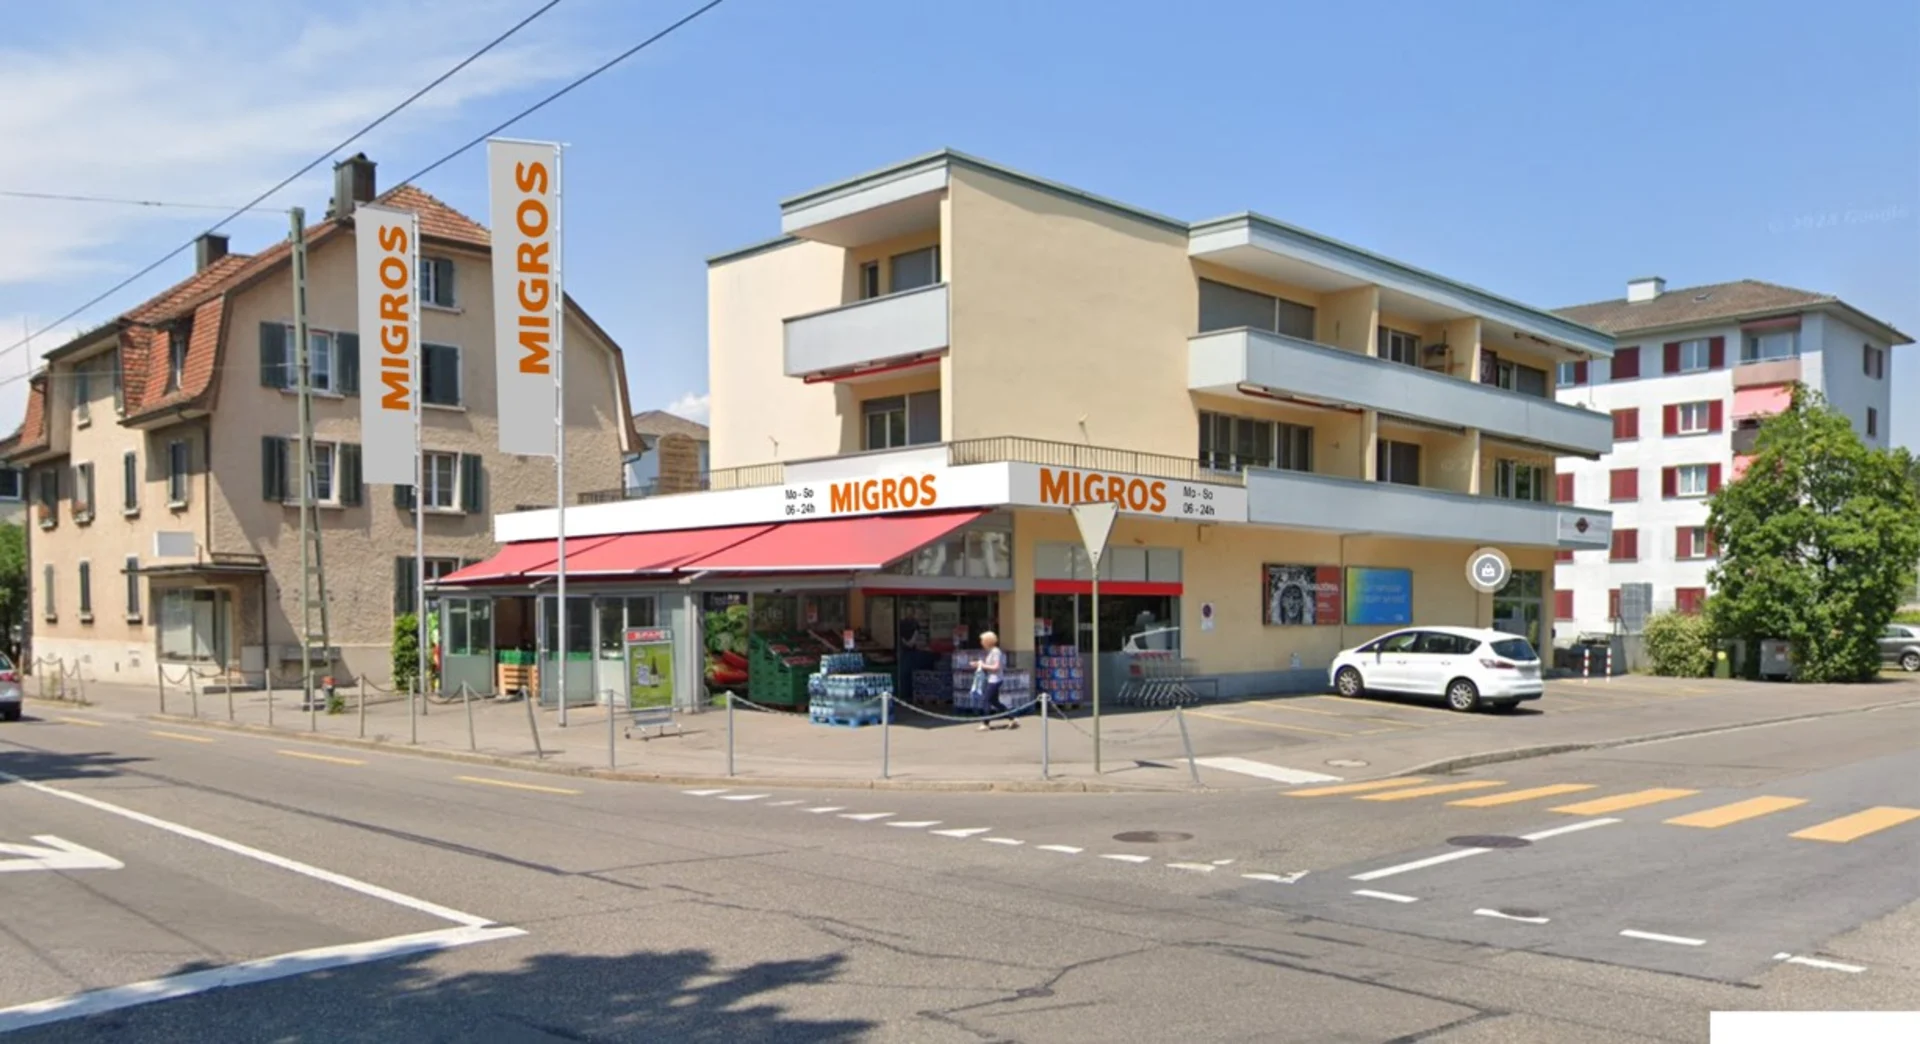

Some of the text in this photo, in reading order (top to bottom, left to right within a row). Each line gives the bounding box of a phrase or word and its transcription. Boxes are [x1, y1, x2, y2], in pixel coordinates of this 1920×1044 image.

[516, 161, 551, 375] MIGROS
[378, 225, 410, 411] MIGROS
[803, 487, 814, 499] So
[830, 474, 937, 514] MIGROS
[1039, 468, 1168, 513] MIGROS
[1202, 488, 1214, 500] So
[801, 503, 816, 515] 24h
[1200, 503, 1216, 516] 24h
